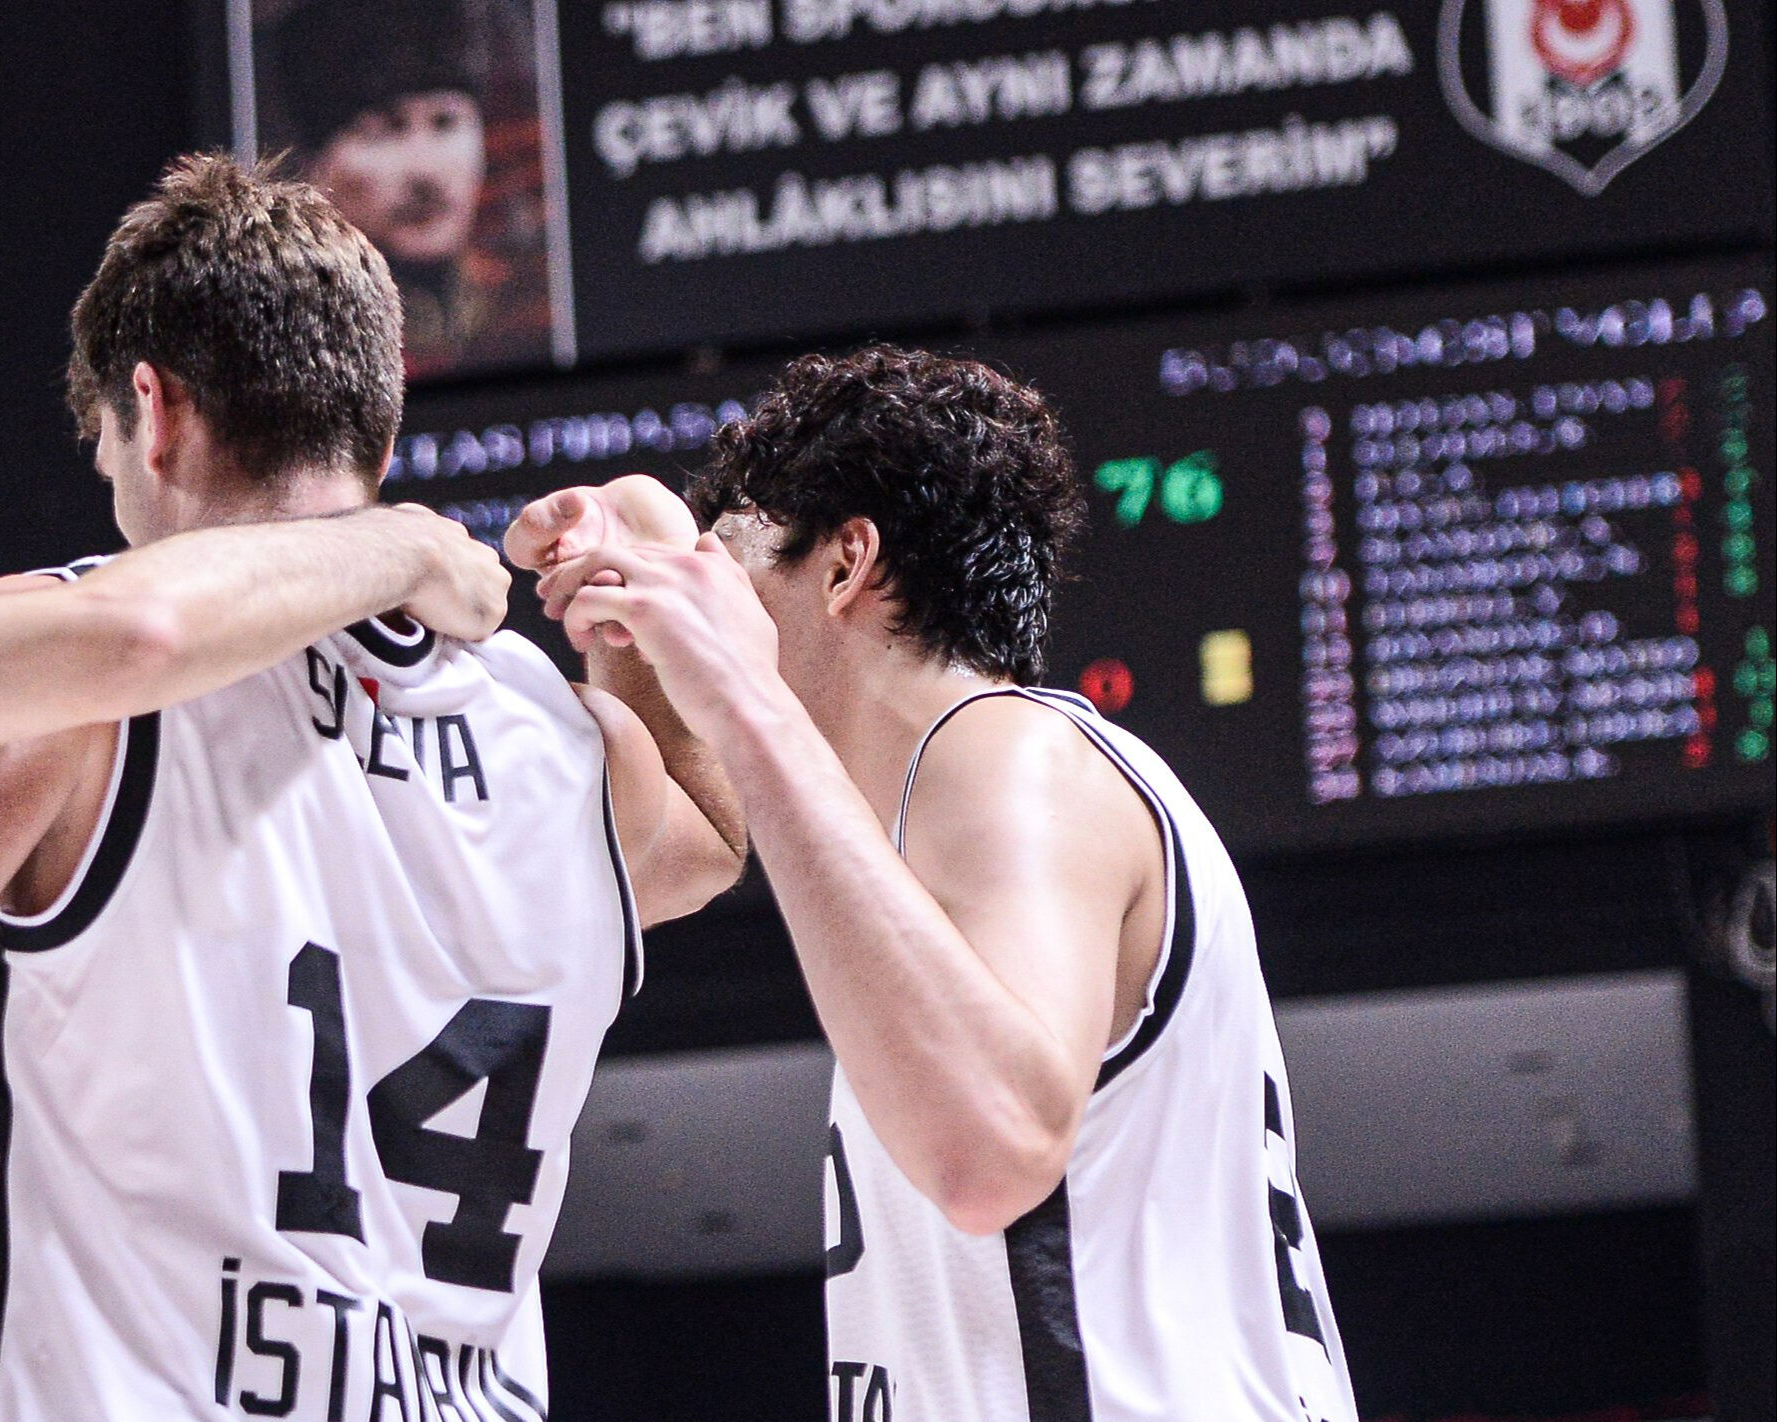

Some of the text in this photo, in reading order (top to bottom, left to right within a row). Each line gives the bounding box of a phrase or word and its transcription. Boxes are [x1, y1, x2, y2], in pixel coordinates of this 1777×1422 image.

[593, 75, 801, 178] ÇEVİK
[806, 70, 903, 141] VE
[909, 48, 1072, 129] AYNI
[1079, 10, 1416, 111] ZAMANDA
[1094, 450, 1223, 528] 76
[276, 940, 552, 1292] 14
